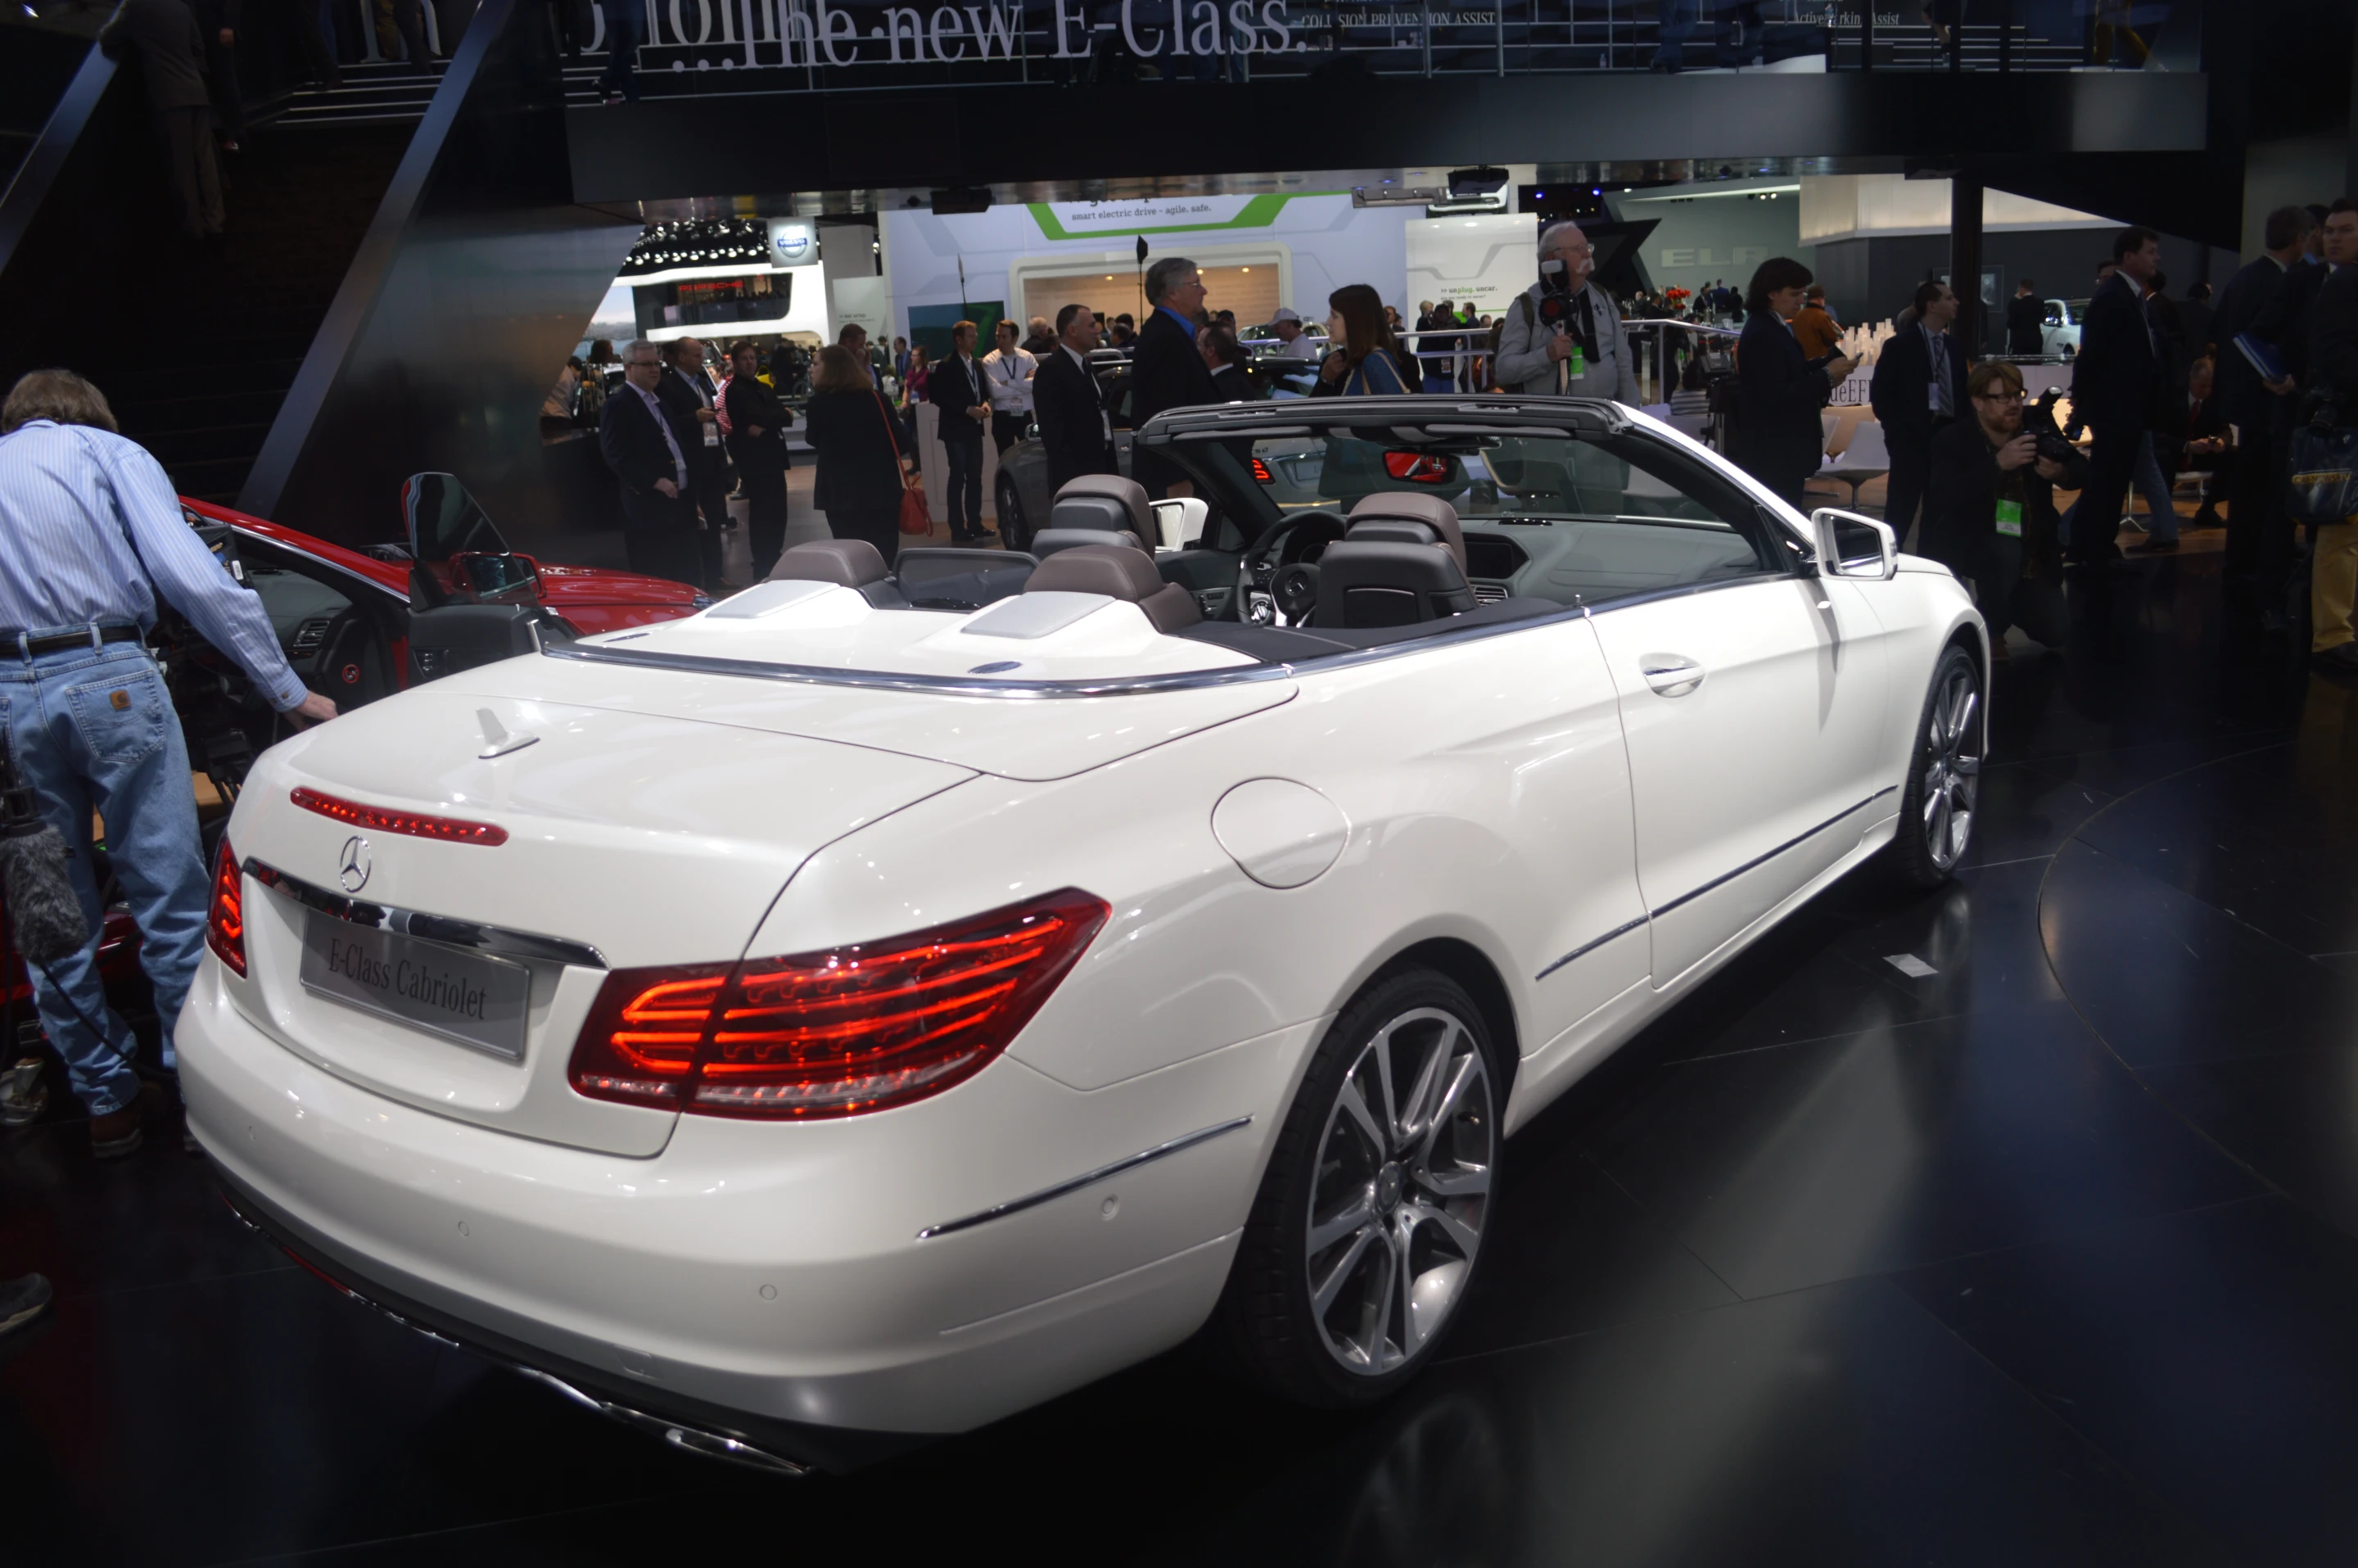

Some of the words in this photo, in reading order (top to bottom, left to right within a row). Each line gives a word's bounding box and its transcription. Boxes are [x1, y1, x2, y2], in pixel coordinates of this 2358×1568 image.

[1302, 13, 1367, 27] COLLSION
[1454, 11, 1495, 25] ASSIST
[882, 4, 1023, 63] new
[1072, 211, 1095, 220] smart
[1099, 209, 1132, 219] electric
[1135, 207, 1156, 216] drive
[1191, 204, 1212, 213] safe.
[1661, 246, 1768, 268] ELR
[679, 279, 744, 291] PORSCHE
[329, 938, 391, 990] E-Class
[397, 959, 487, 1020] Cabriolet
